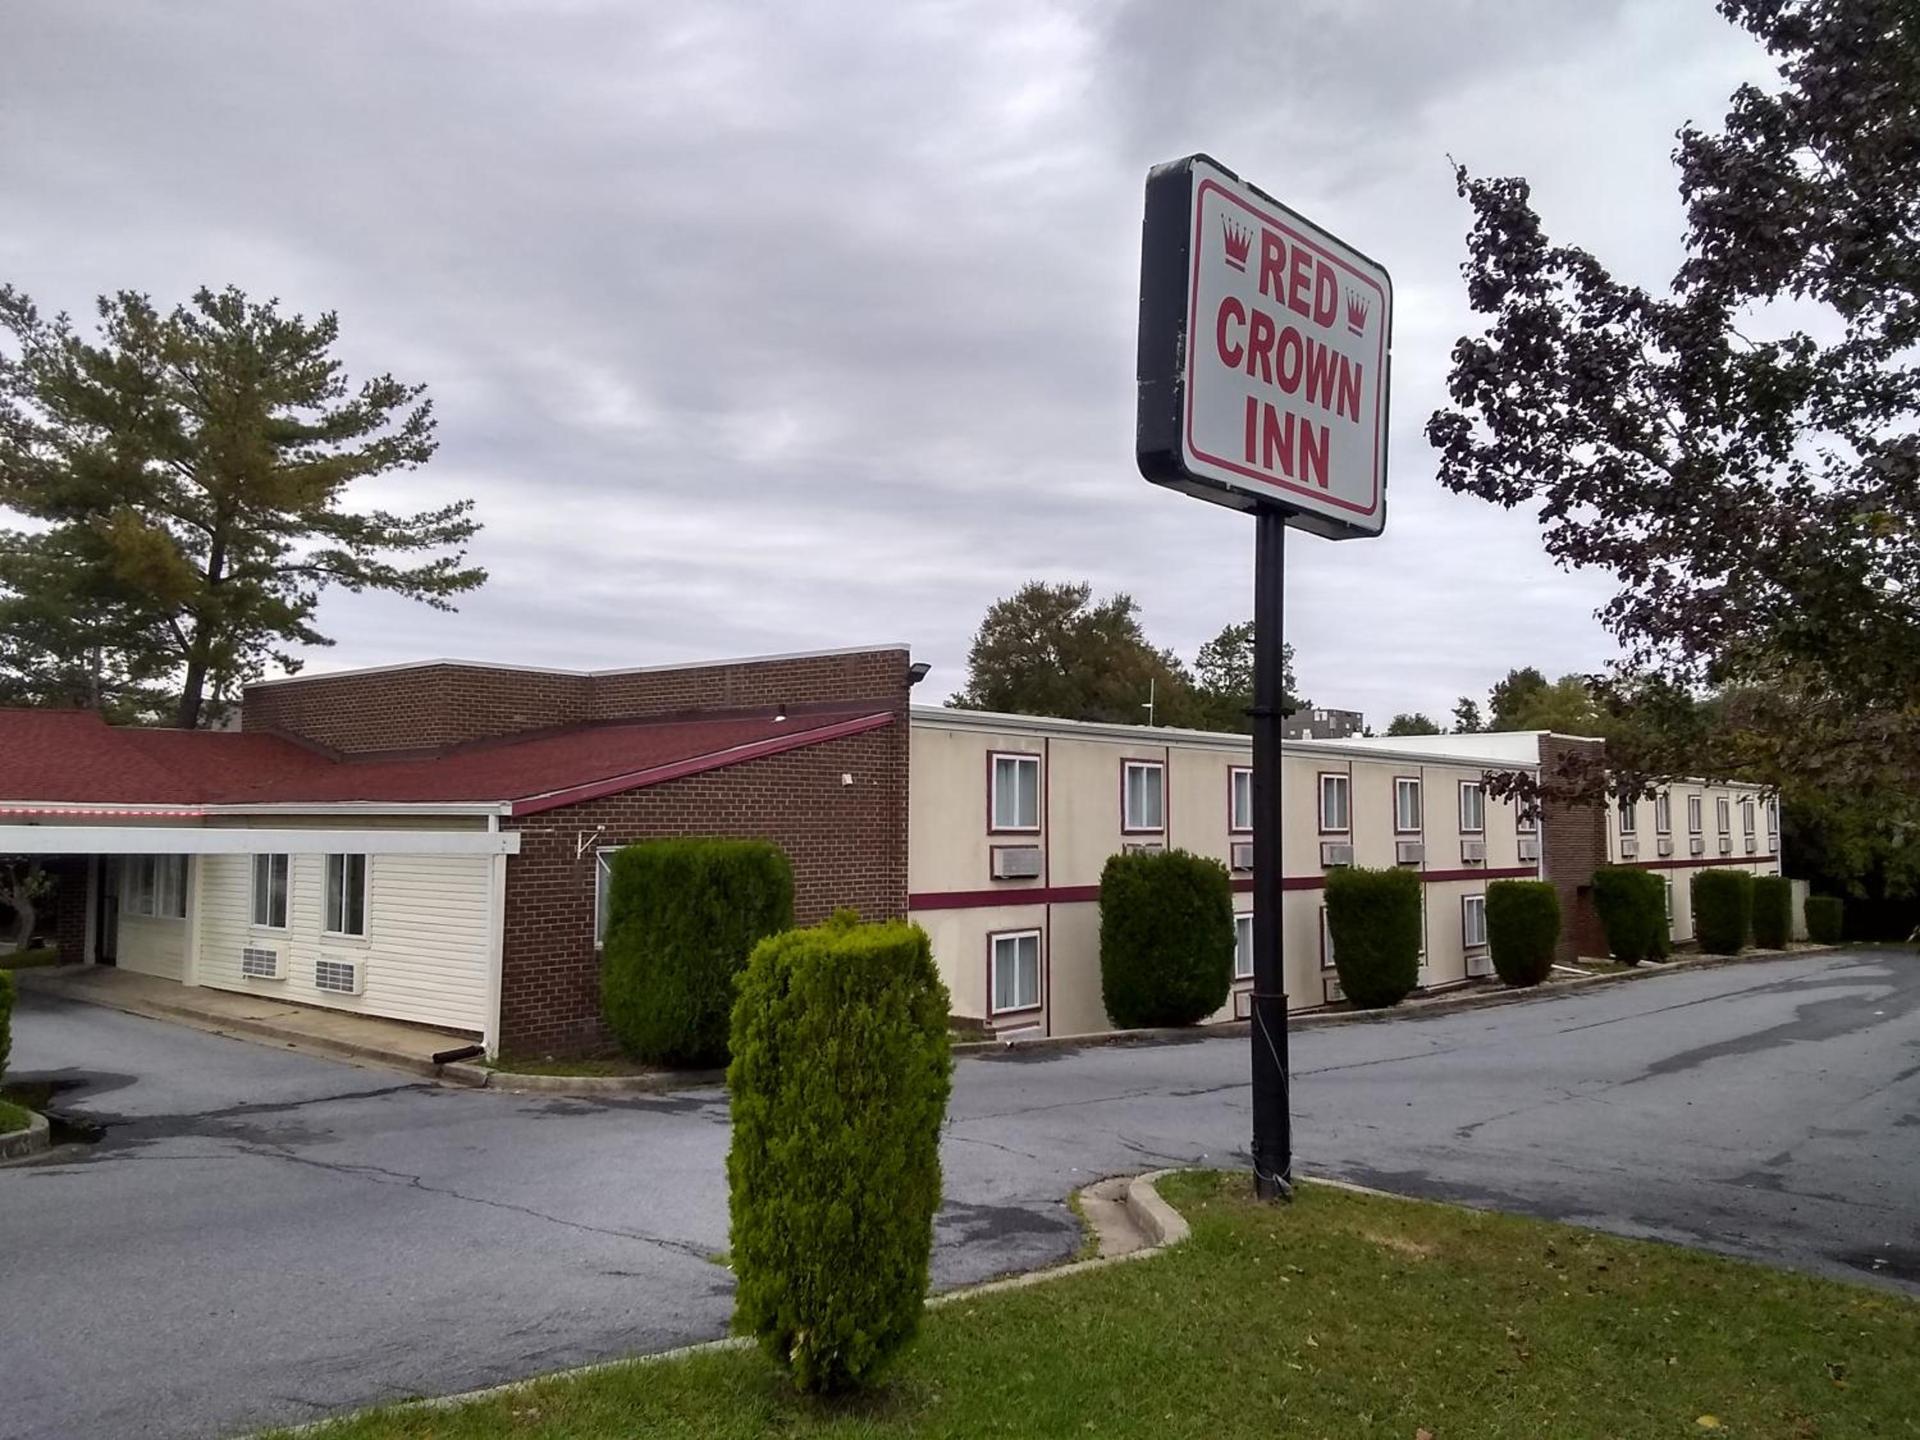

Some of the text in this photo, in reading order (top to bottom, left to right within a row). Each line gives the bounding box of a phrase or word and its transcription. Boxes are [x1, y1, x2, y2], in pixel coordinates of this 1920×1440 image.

[1259, 227, 1338, 329] RED
[1216, 296, 1363, 424] CROWN
[1245, 395, 1330, 489] INN
